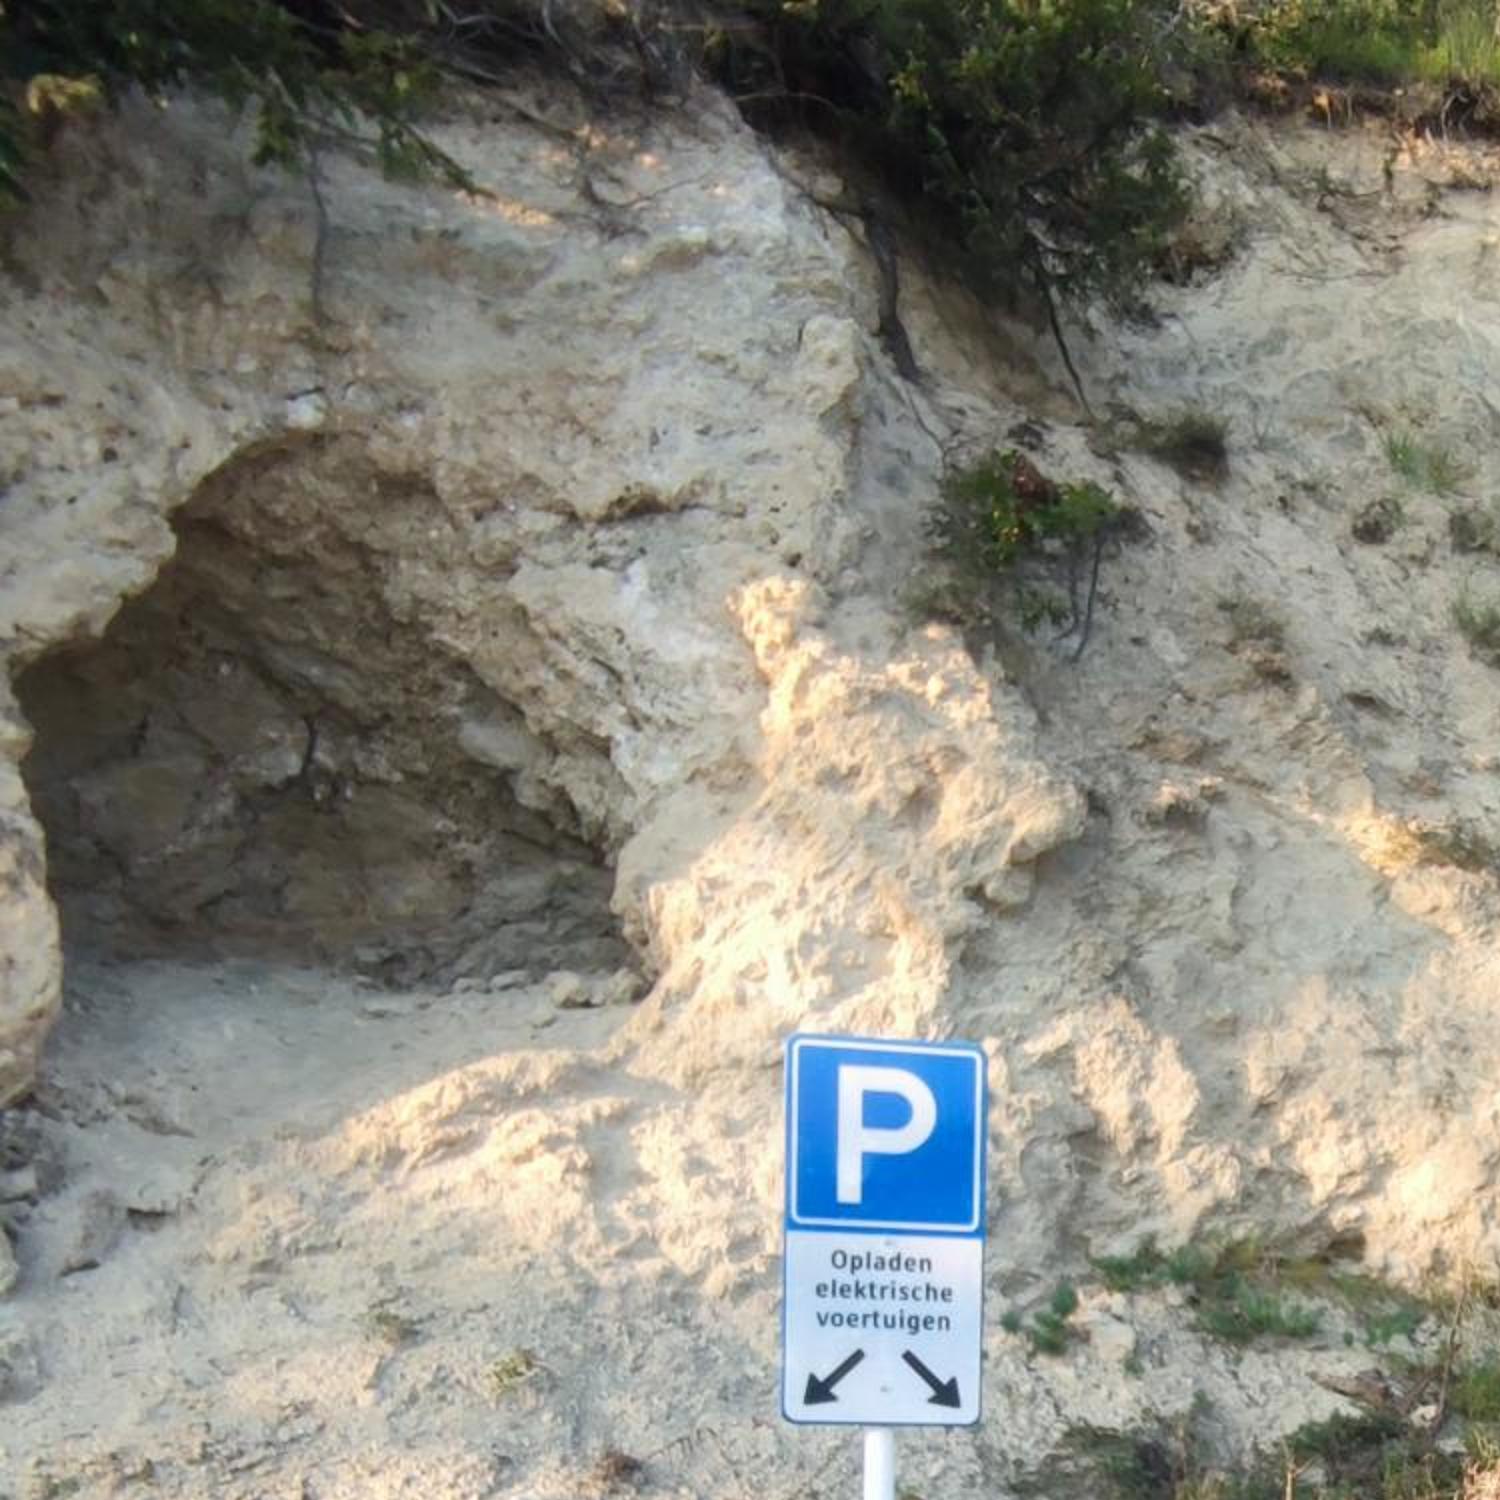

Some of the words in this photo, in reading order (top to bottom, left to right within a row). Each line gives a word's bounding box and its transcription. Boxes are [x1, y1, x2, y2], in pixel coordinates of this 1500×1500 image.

[836, 1063, 937, 1205] P
[831, 1249, 932, 1274] Opladen
[815, 1280, 953, 1303] elektrische
[816, 1309, 951, 1335] voertuigen
